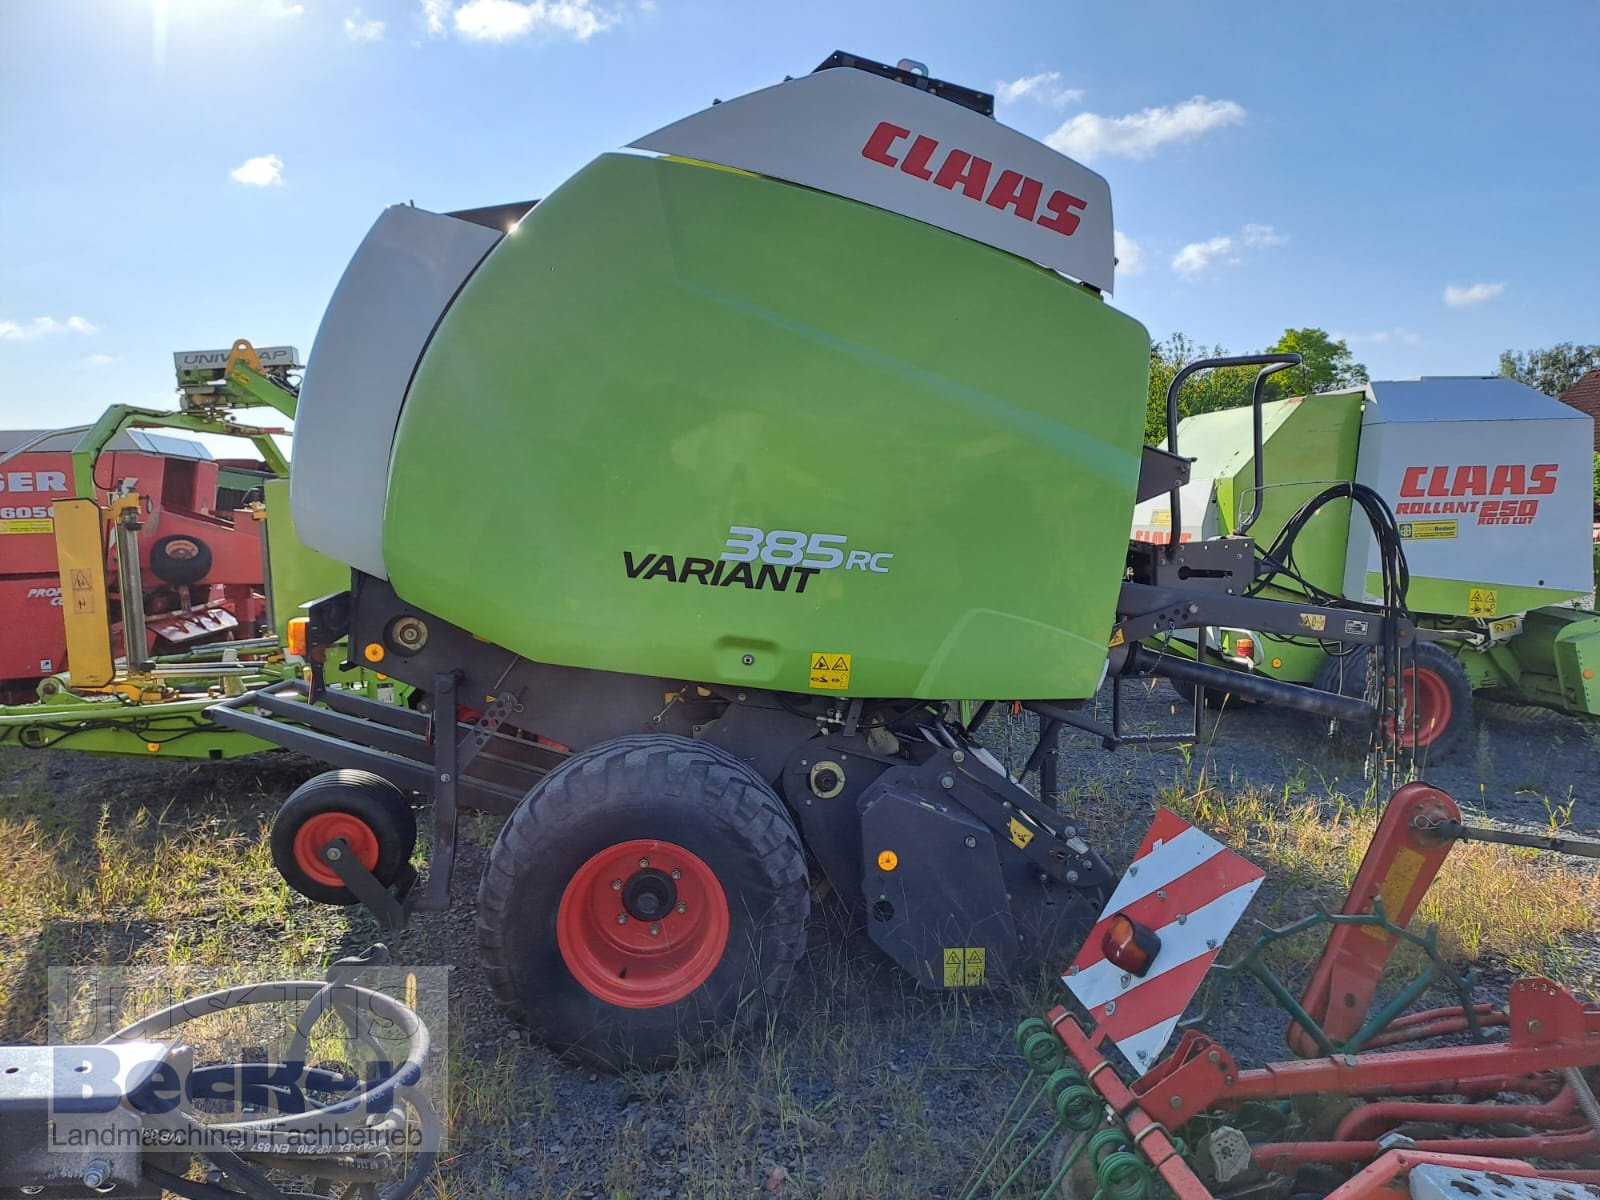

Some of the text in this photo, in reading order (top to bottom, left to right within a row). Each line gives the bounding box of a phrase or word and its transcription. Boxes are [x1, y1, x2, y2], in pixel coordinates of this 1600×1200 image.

[862, 121, 1087, 237] CLAAS
[0, 471, 68, 492] ER
[1400, 464, 1559, 498] CLAAS
[1395, 500, 1539, 518] ROLLANT 250
[1477, 516, 1534, 526] ROTO CUT
[720, 526, 894, 573] 385 RC
[623, 551, 821, 593] VARIANT
[250, 1142, 271, 1153] 857
[273, 1143, 290, 1154] EN
[297, 1144, 316, 1154] 210
